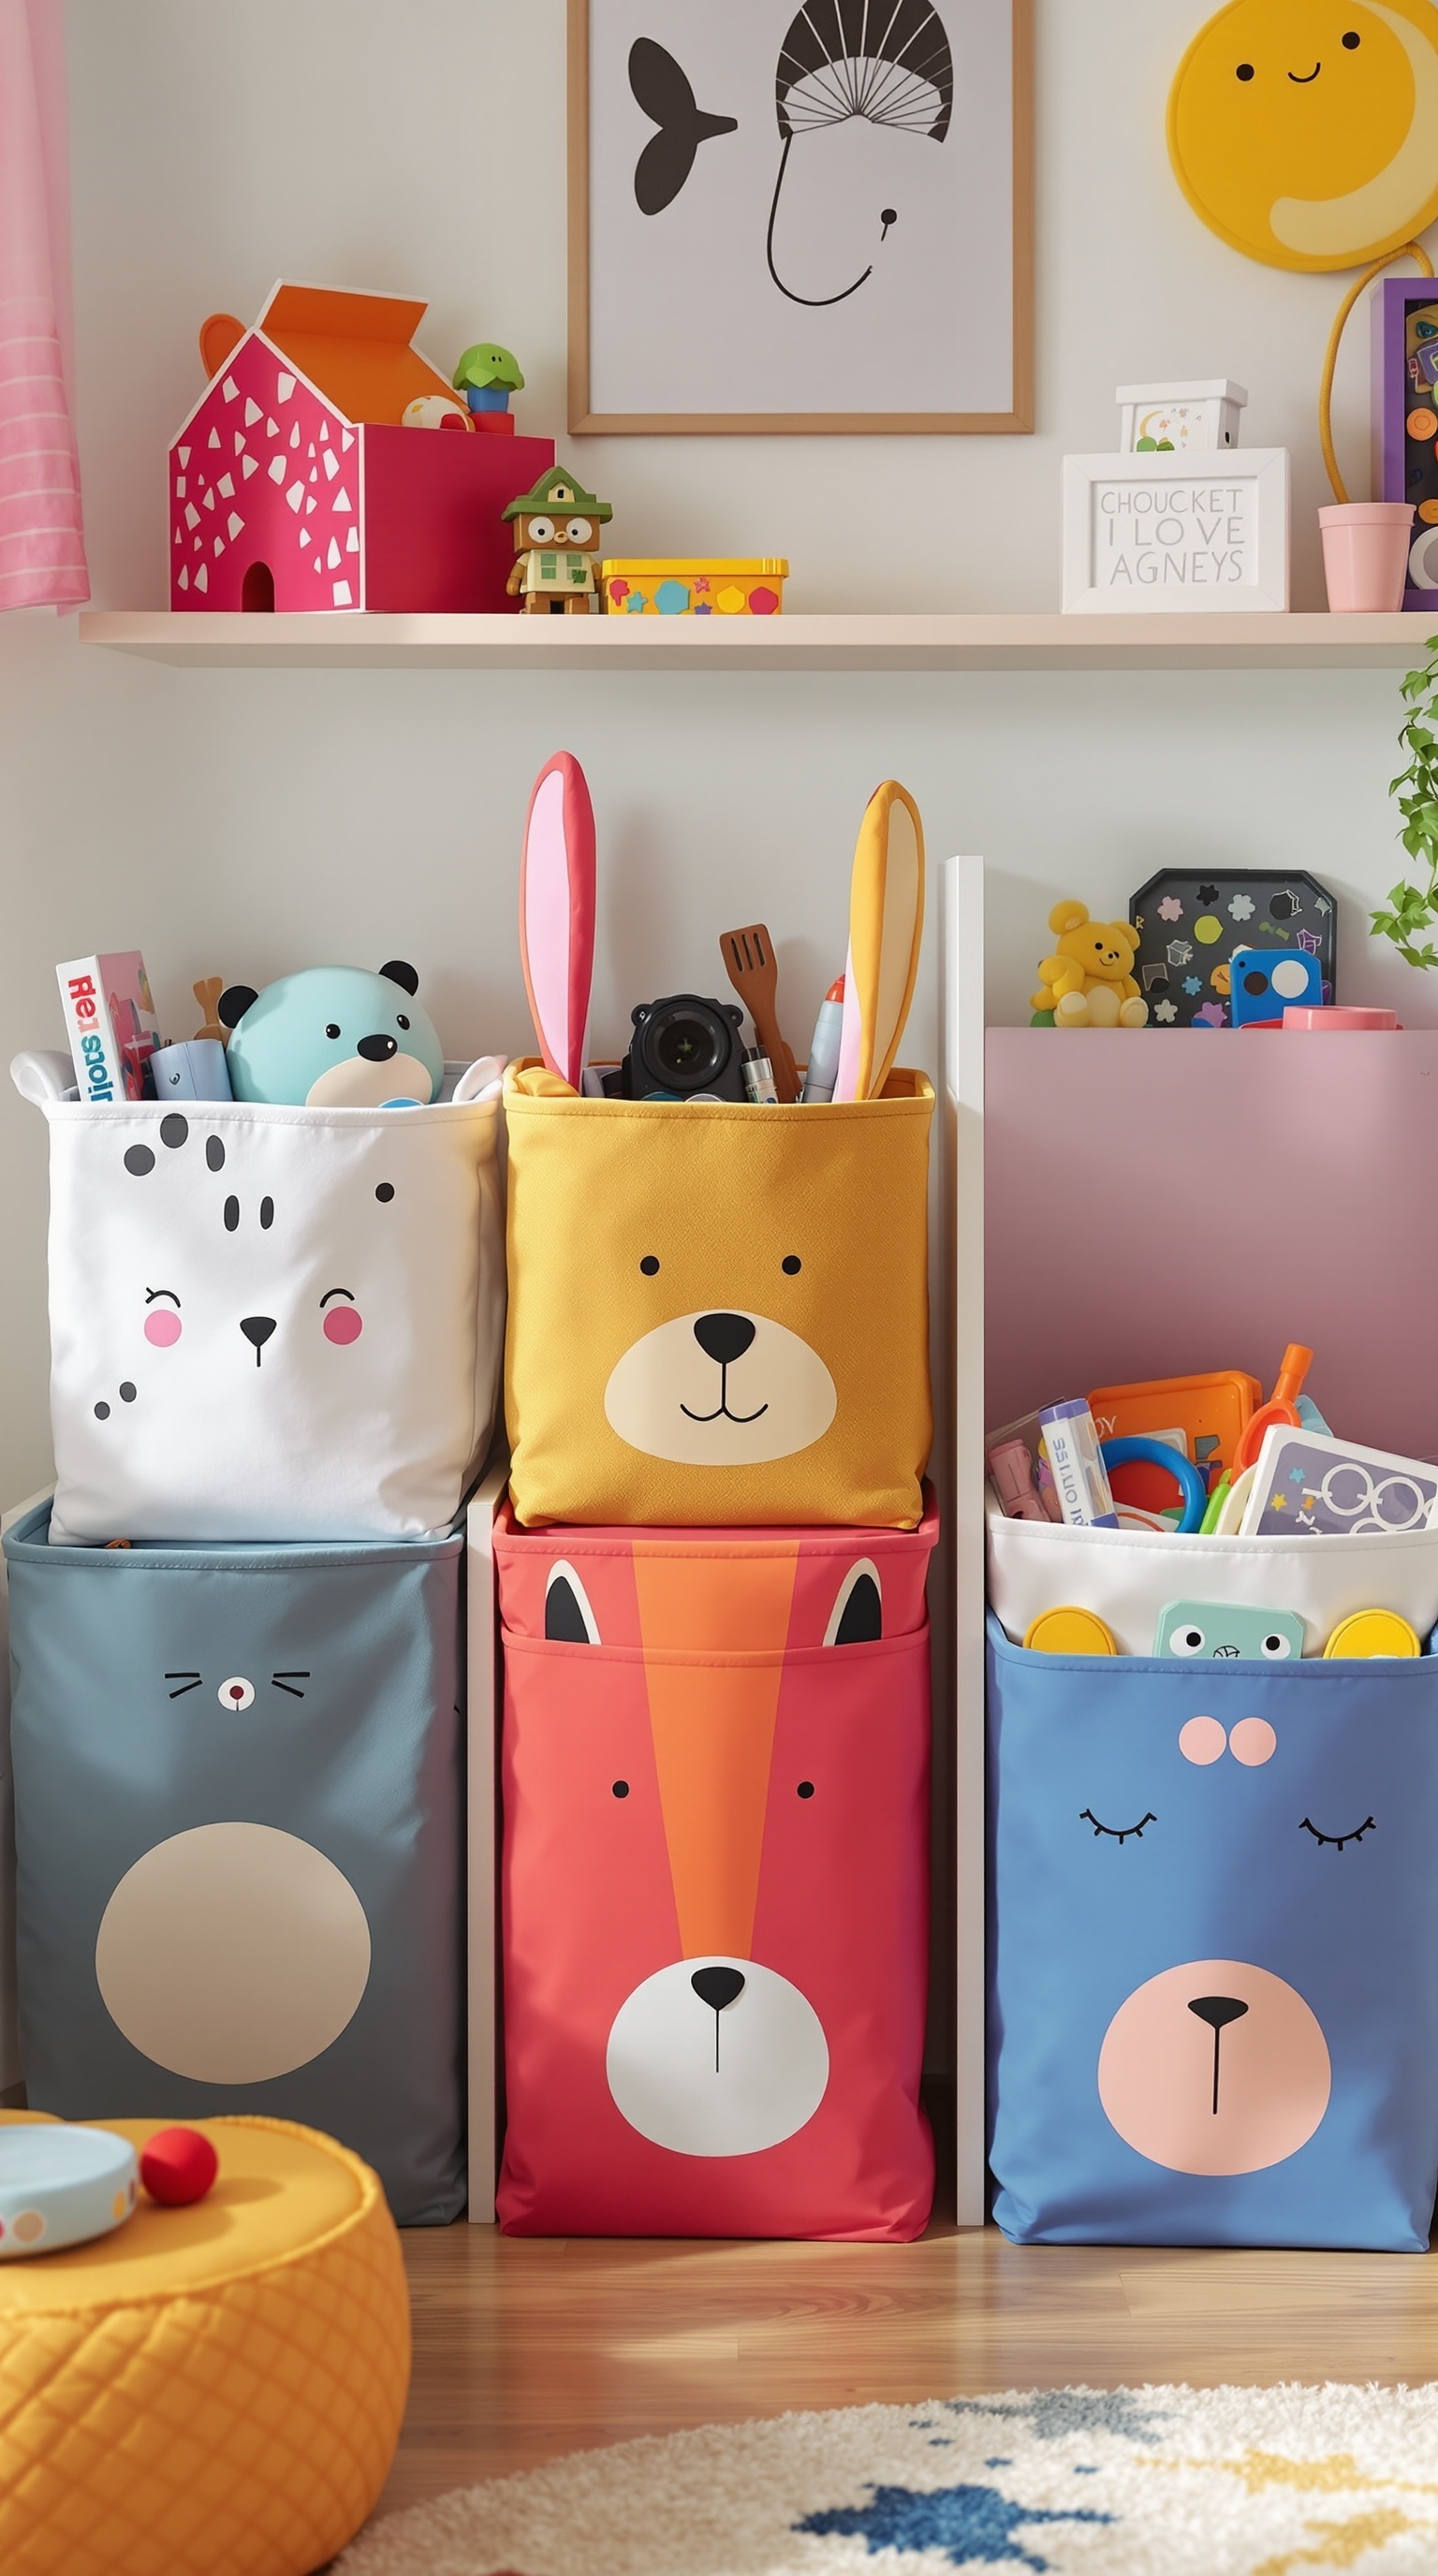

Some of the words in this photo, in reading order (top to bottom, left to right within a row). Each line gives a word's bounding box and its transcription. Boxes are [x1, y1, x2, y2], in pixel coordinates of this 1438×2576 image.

[1100, 489, 1243, 515] CHOUCKET
[1108, 518, 1115, 547] I
[1134, 516, 1246, 547] LOVE
[1108, 549, 1244, 586] AGNEYS
